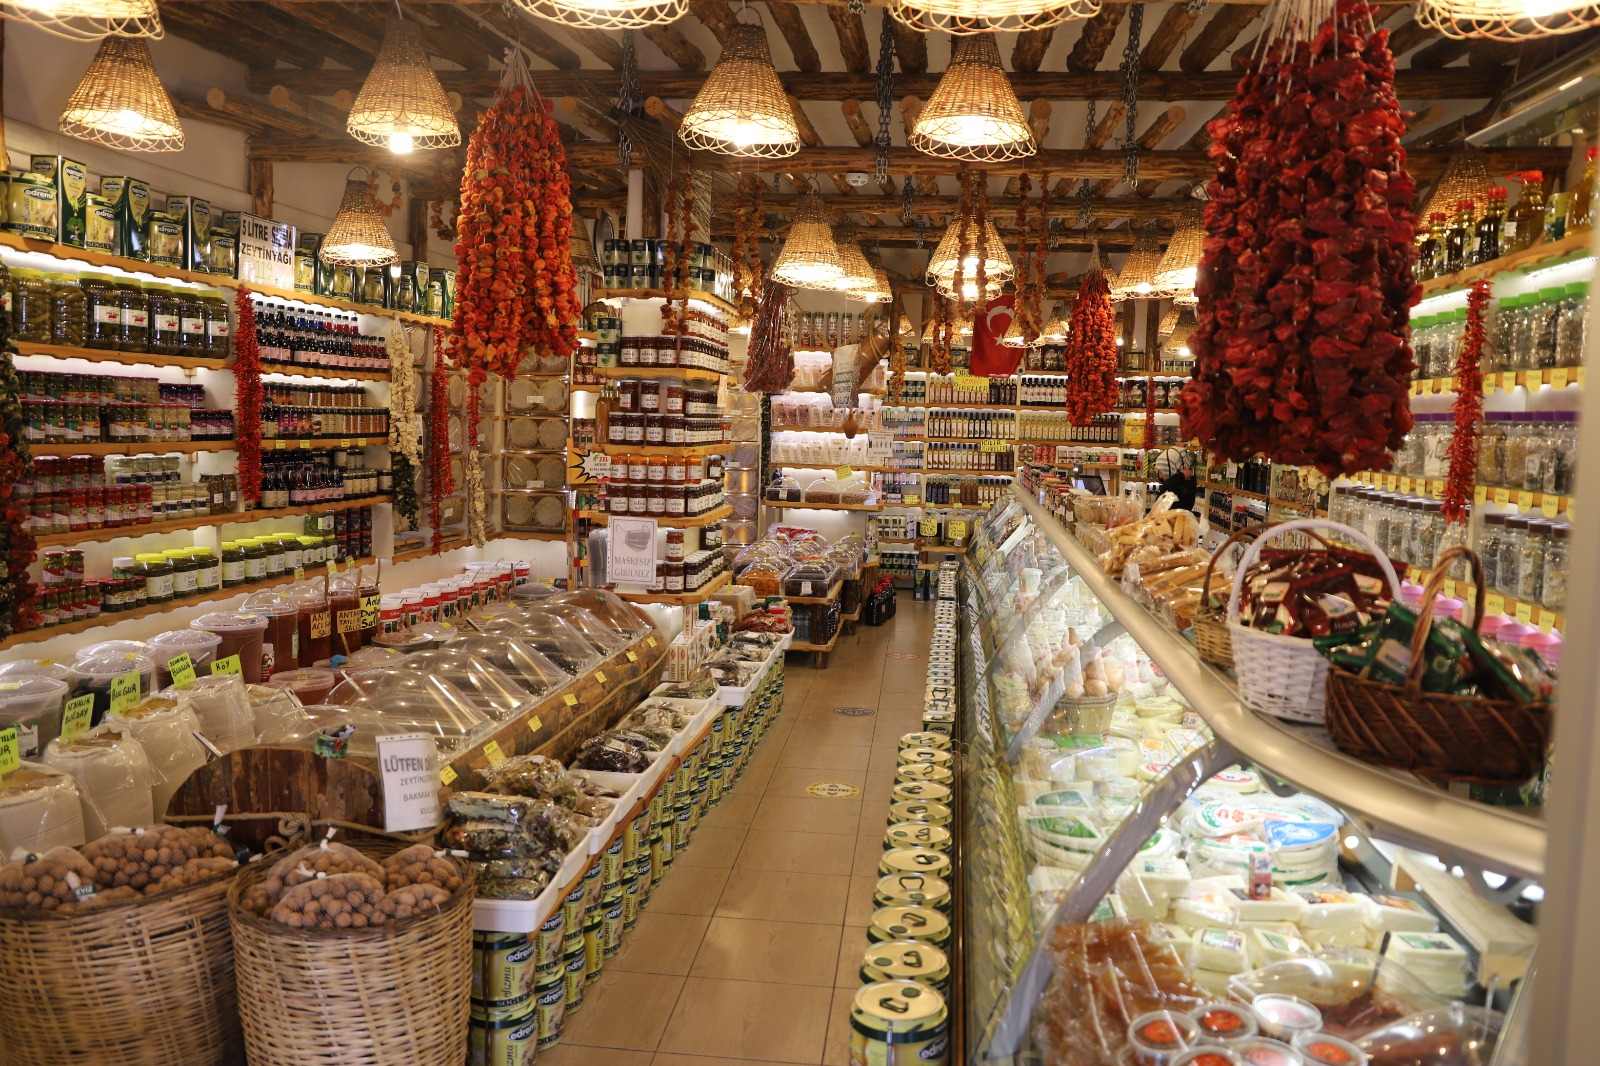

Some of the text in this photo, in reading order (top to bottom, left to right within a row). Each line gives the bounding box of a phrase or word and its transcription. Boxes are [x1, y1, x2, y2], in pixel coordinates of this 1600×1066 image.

[242, 219, 247, 235] 5
[248, 218, 268, 241] LİTRE
[614, 555, 651, 566] MASKESİZ
[614, 567, 650, 579] GİRİLMEZ
[215, 659, 230, 671] KÖY
[111, 683, 137, 701] BULGUR
[384, 754, 423, 772] LÜTFEN
